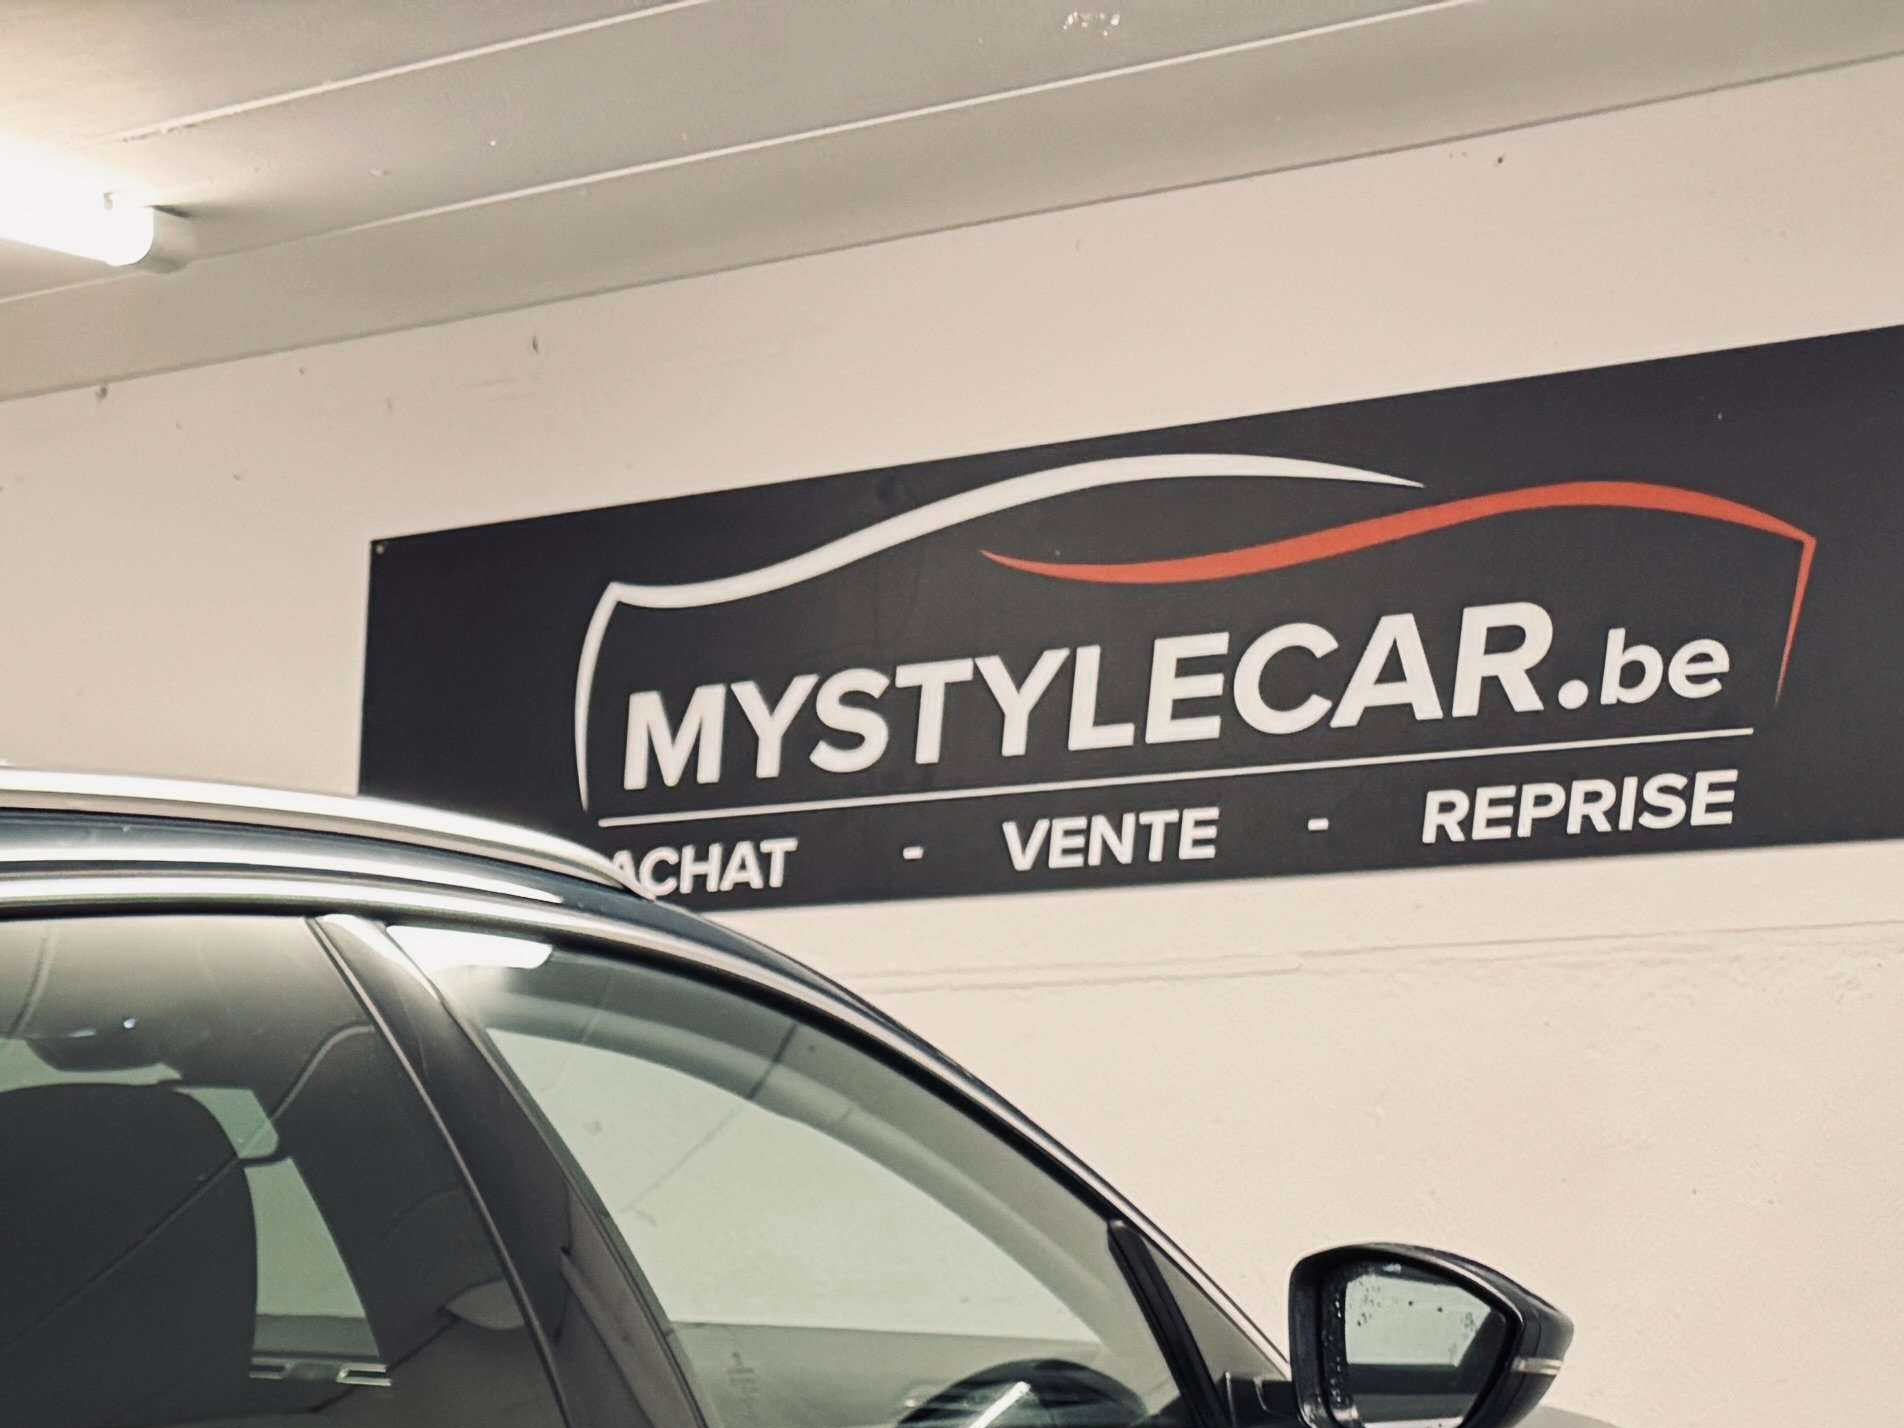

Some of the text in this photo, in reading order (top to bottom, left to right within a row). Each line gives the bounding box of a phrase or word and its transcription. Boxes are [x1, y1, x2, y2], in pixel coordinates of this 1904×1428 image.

[623, 602, 1731, 791] MYSTYLECAR.be
[612, 838, 799, 898] ACHAT
[1002, 807, 1220, 871] VENTE
[1422, 769, 1739, 844] REPRISE
